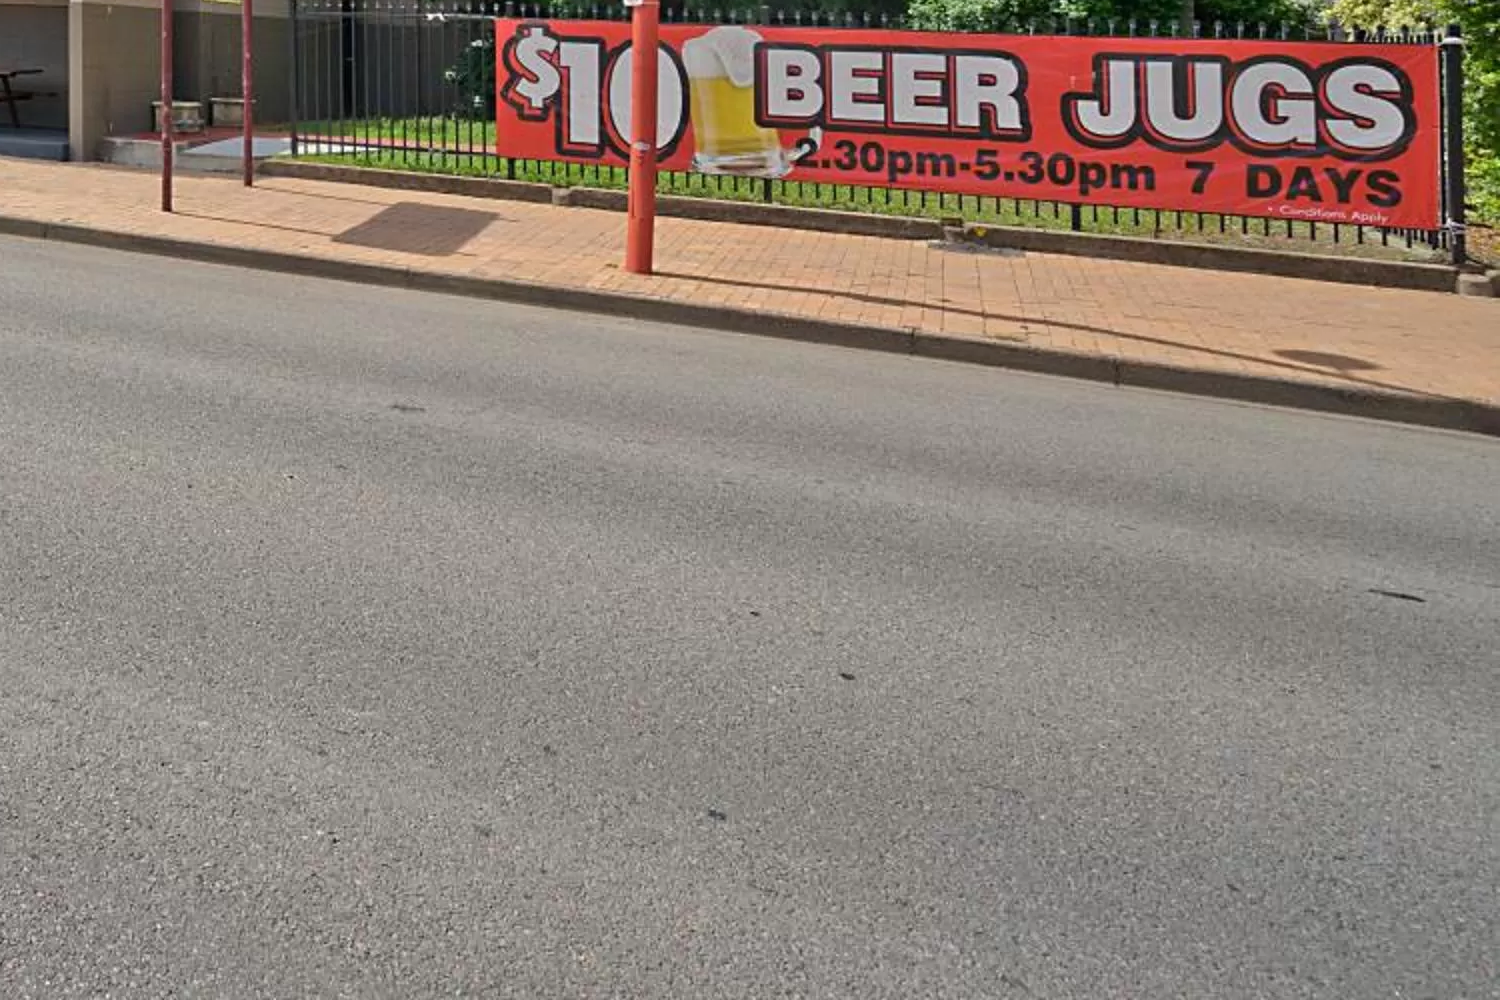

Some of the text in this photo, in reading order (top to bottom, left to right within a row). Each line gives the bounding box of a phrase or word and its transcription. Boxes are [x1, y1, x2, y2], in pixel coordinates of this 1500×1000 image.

[508, 25, 1412, 158] $10 BEER JUGS
[793, 136, 1404, 208] 2.30pm-5.30pm 7 DAYS
[1279, 205, 1390, 224] Conditions Apply
